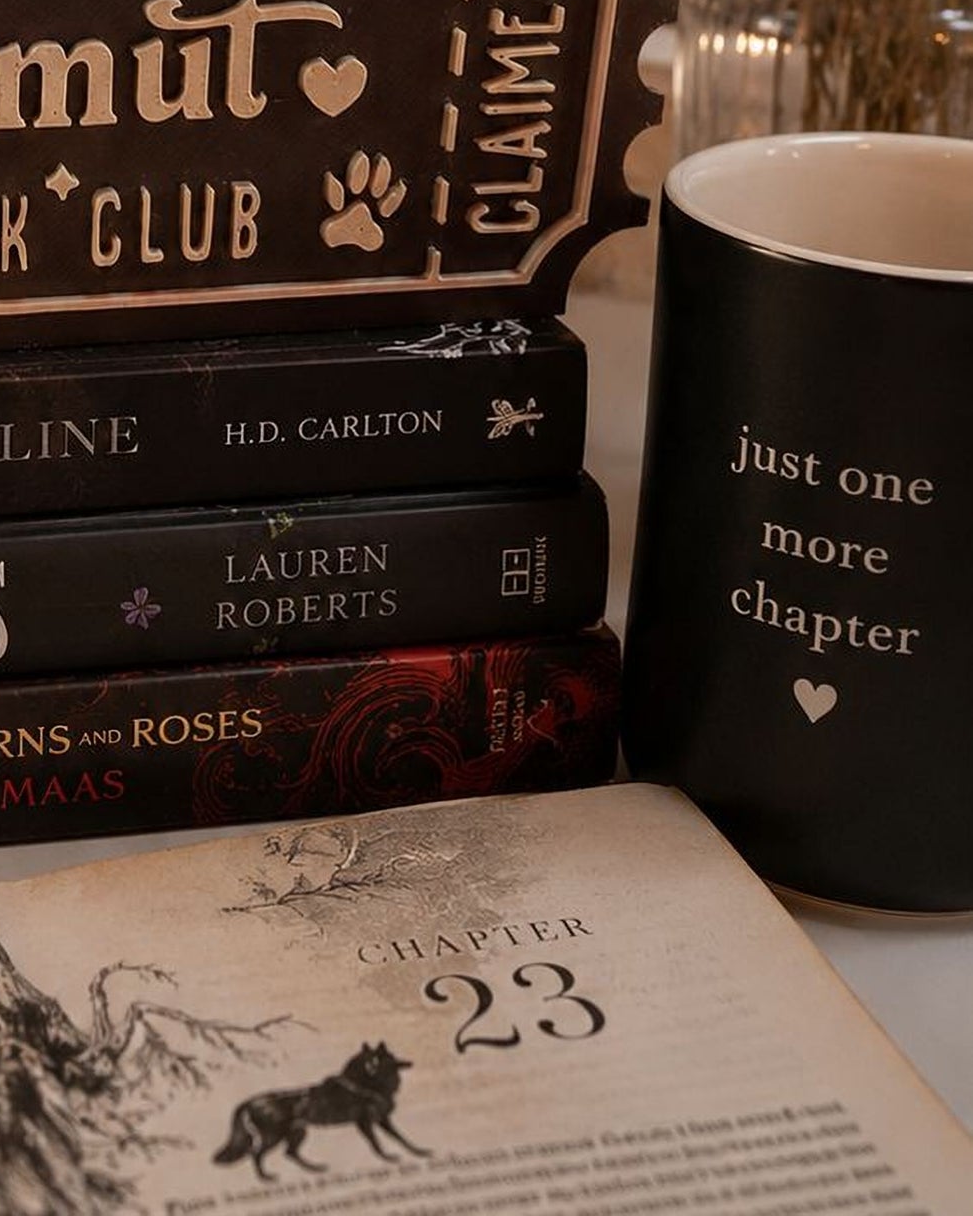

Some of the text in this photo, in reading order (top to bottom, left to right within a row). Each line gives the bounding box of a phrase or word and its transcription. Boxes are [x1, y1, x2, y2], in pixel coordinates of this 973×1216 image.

[91, 182, 261, 267] CLUB
[225, 410, 443, 445] H.D. CARLTON
[731, 425, 934, 505] just one
[225, 544, 388, 584] LAUREN
[761, 520, 889, 575] more
[216, 589, 398, 630] ROBERTS
[731, 579, 920, 655] chapter
[80, 728, 120, 745] AND
[132, 709, 262, 748] ROSES
[1, 771, 125, 809] MAAS
[357, 916, 594, 965] CHAPTER
[424, 961, 606, 1054] 23
